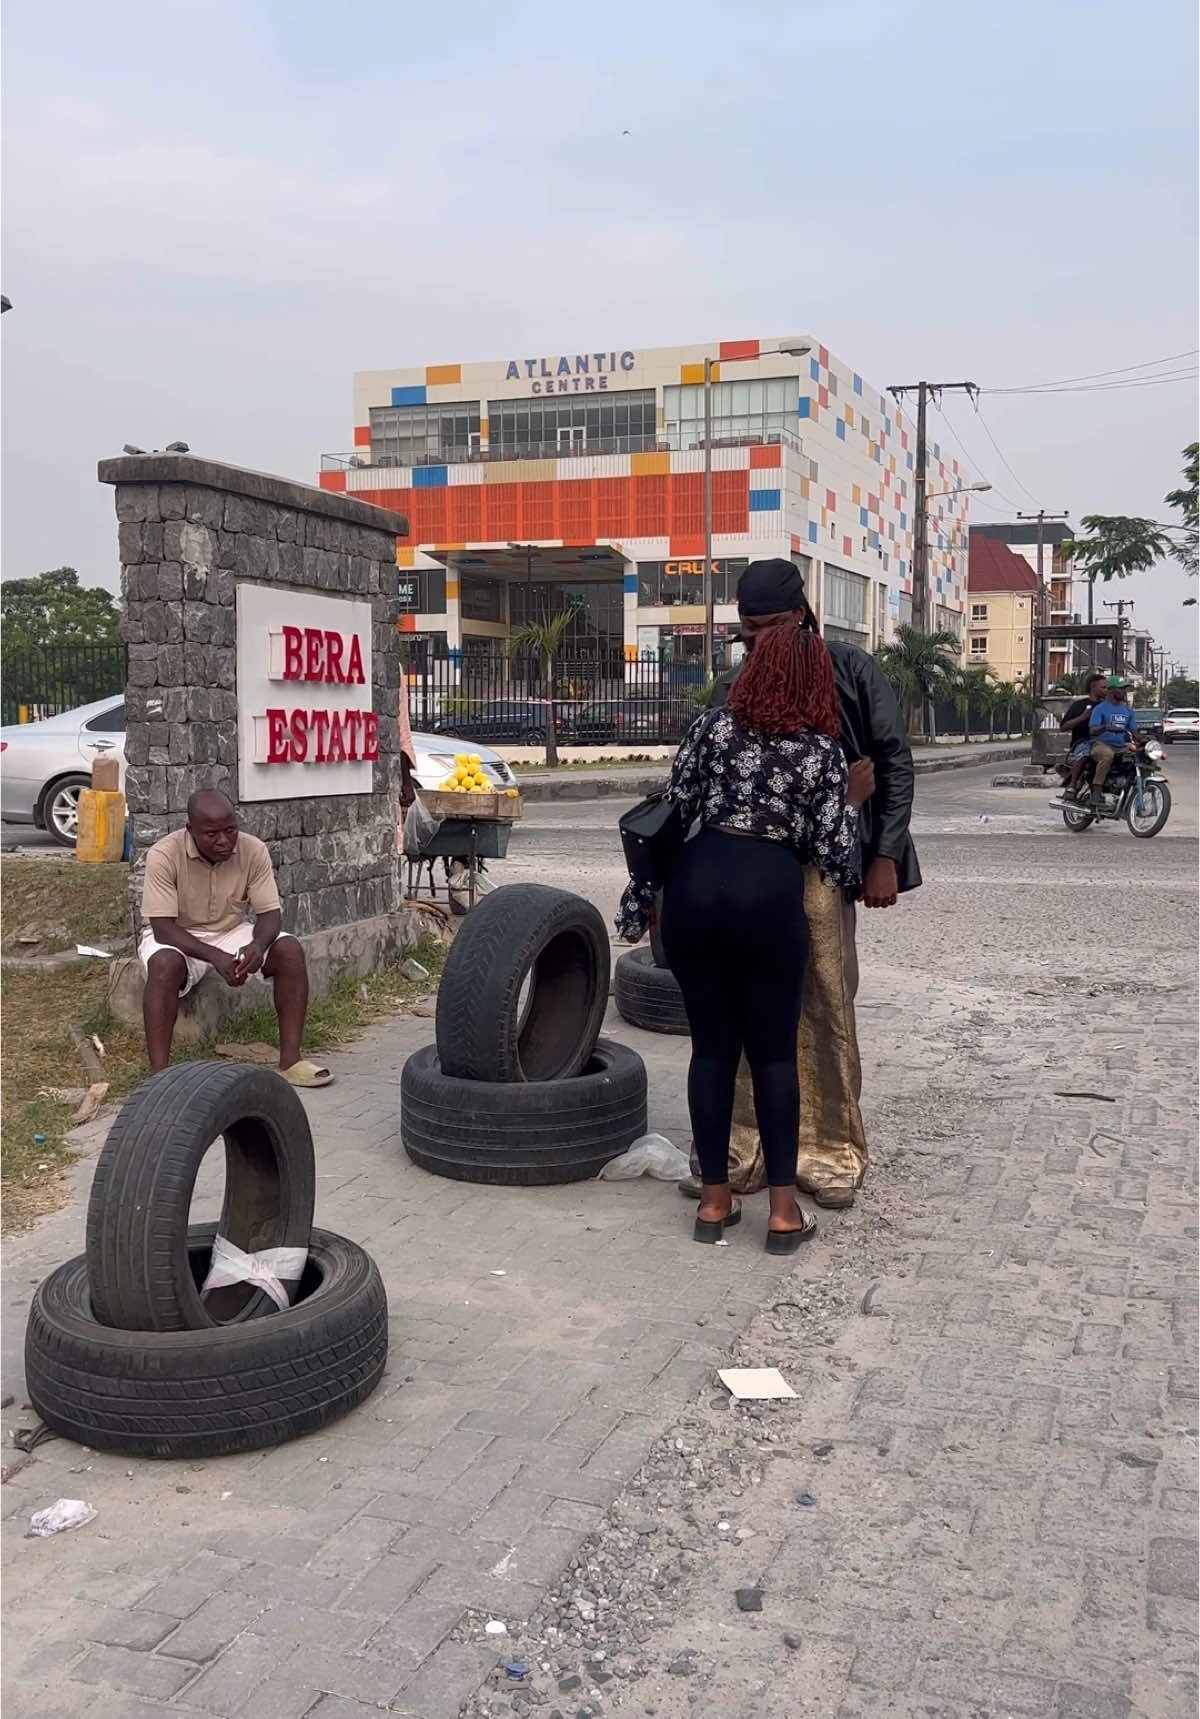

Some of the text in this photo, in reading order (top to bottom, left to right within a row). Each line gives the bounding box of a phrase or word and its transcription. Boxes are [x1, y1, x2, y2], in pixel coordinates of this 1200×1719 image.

[506, 351, 635, 380] ATLANTIC
[531, 376, 608, 394] CENTRE
[282, 625, 366, 685] BERA
[266, 708, 380, 763] ESTATE
